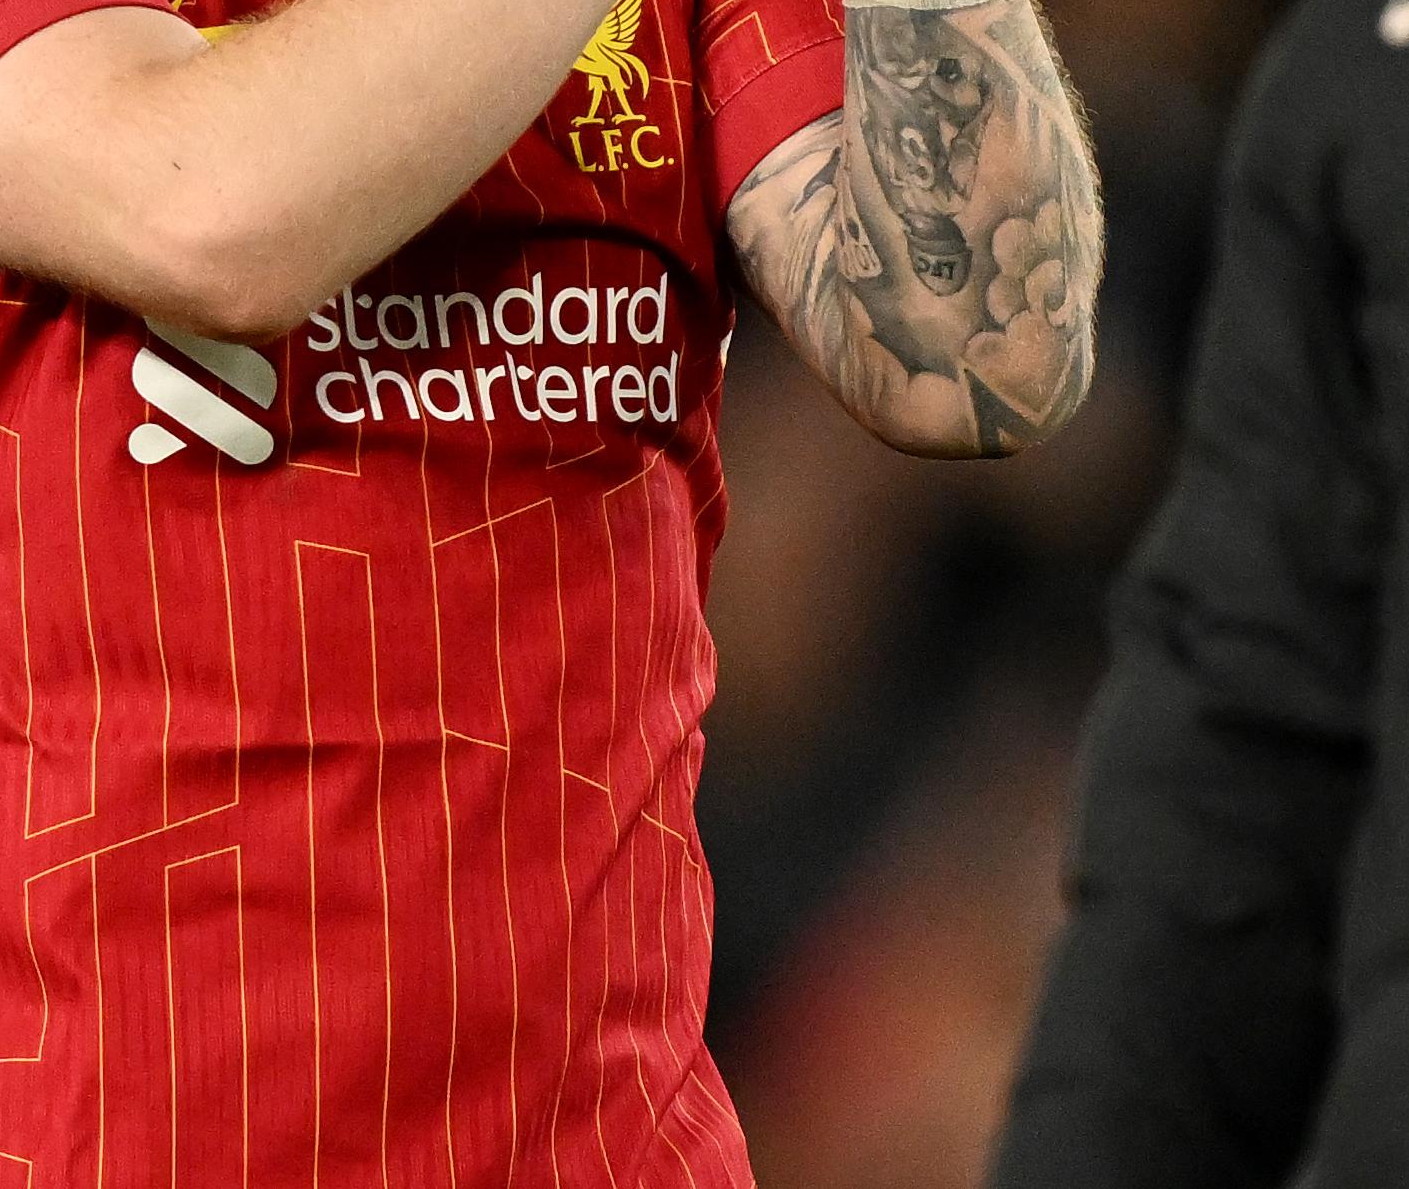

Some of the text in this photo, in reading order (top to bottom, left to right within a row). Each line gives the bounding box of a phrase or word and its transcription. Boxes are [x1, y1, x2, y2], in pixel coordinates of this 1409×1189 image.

[568, 125, 676, 173] L.F.C.
[306, 270, 669, 352] standard
[314, 349, 680, 424] chartered
